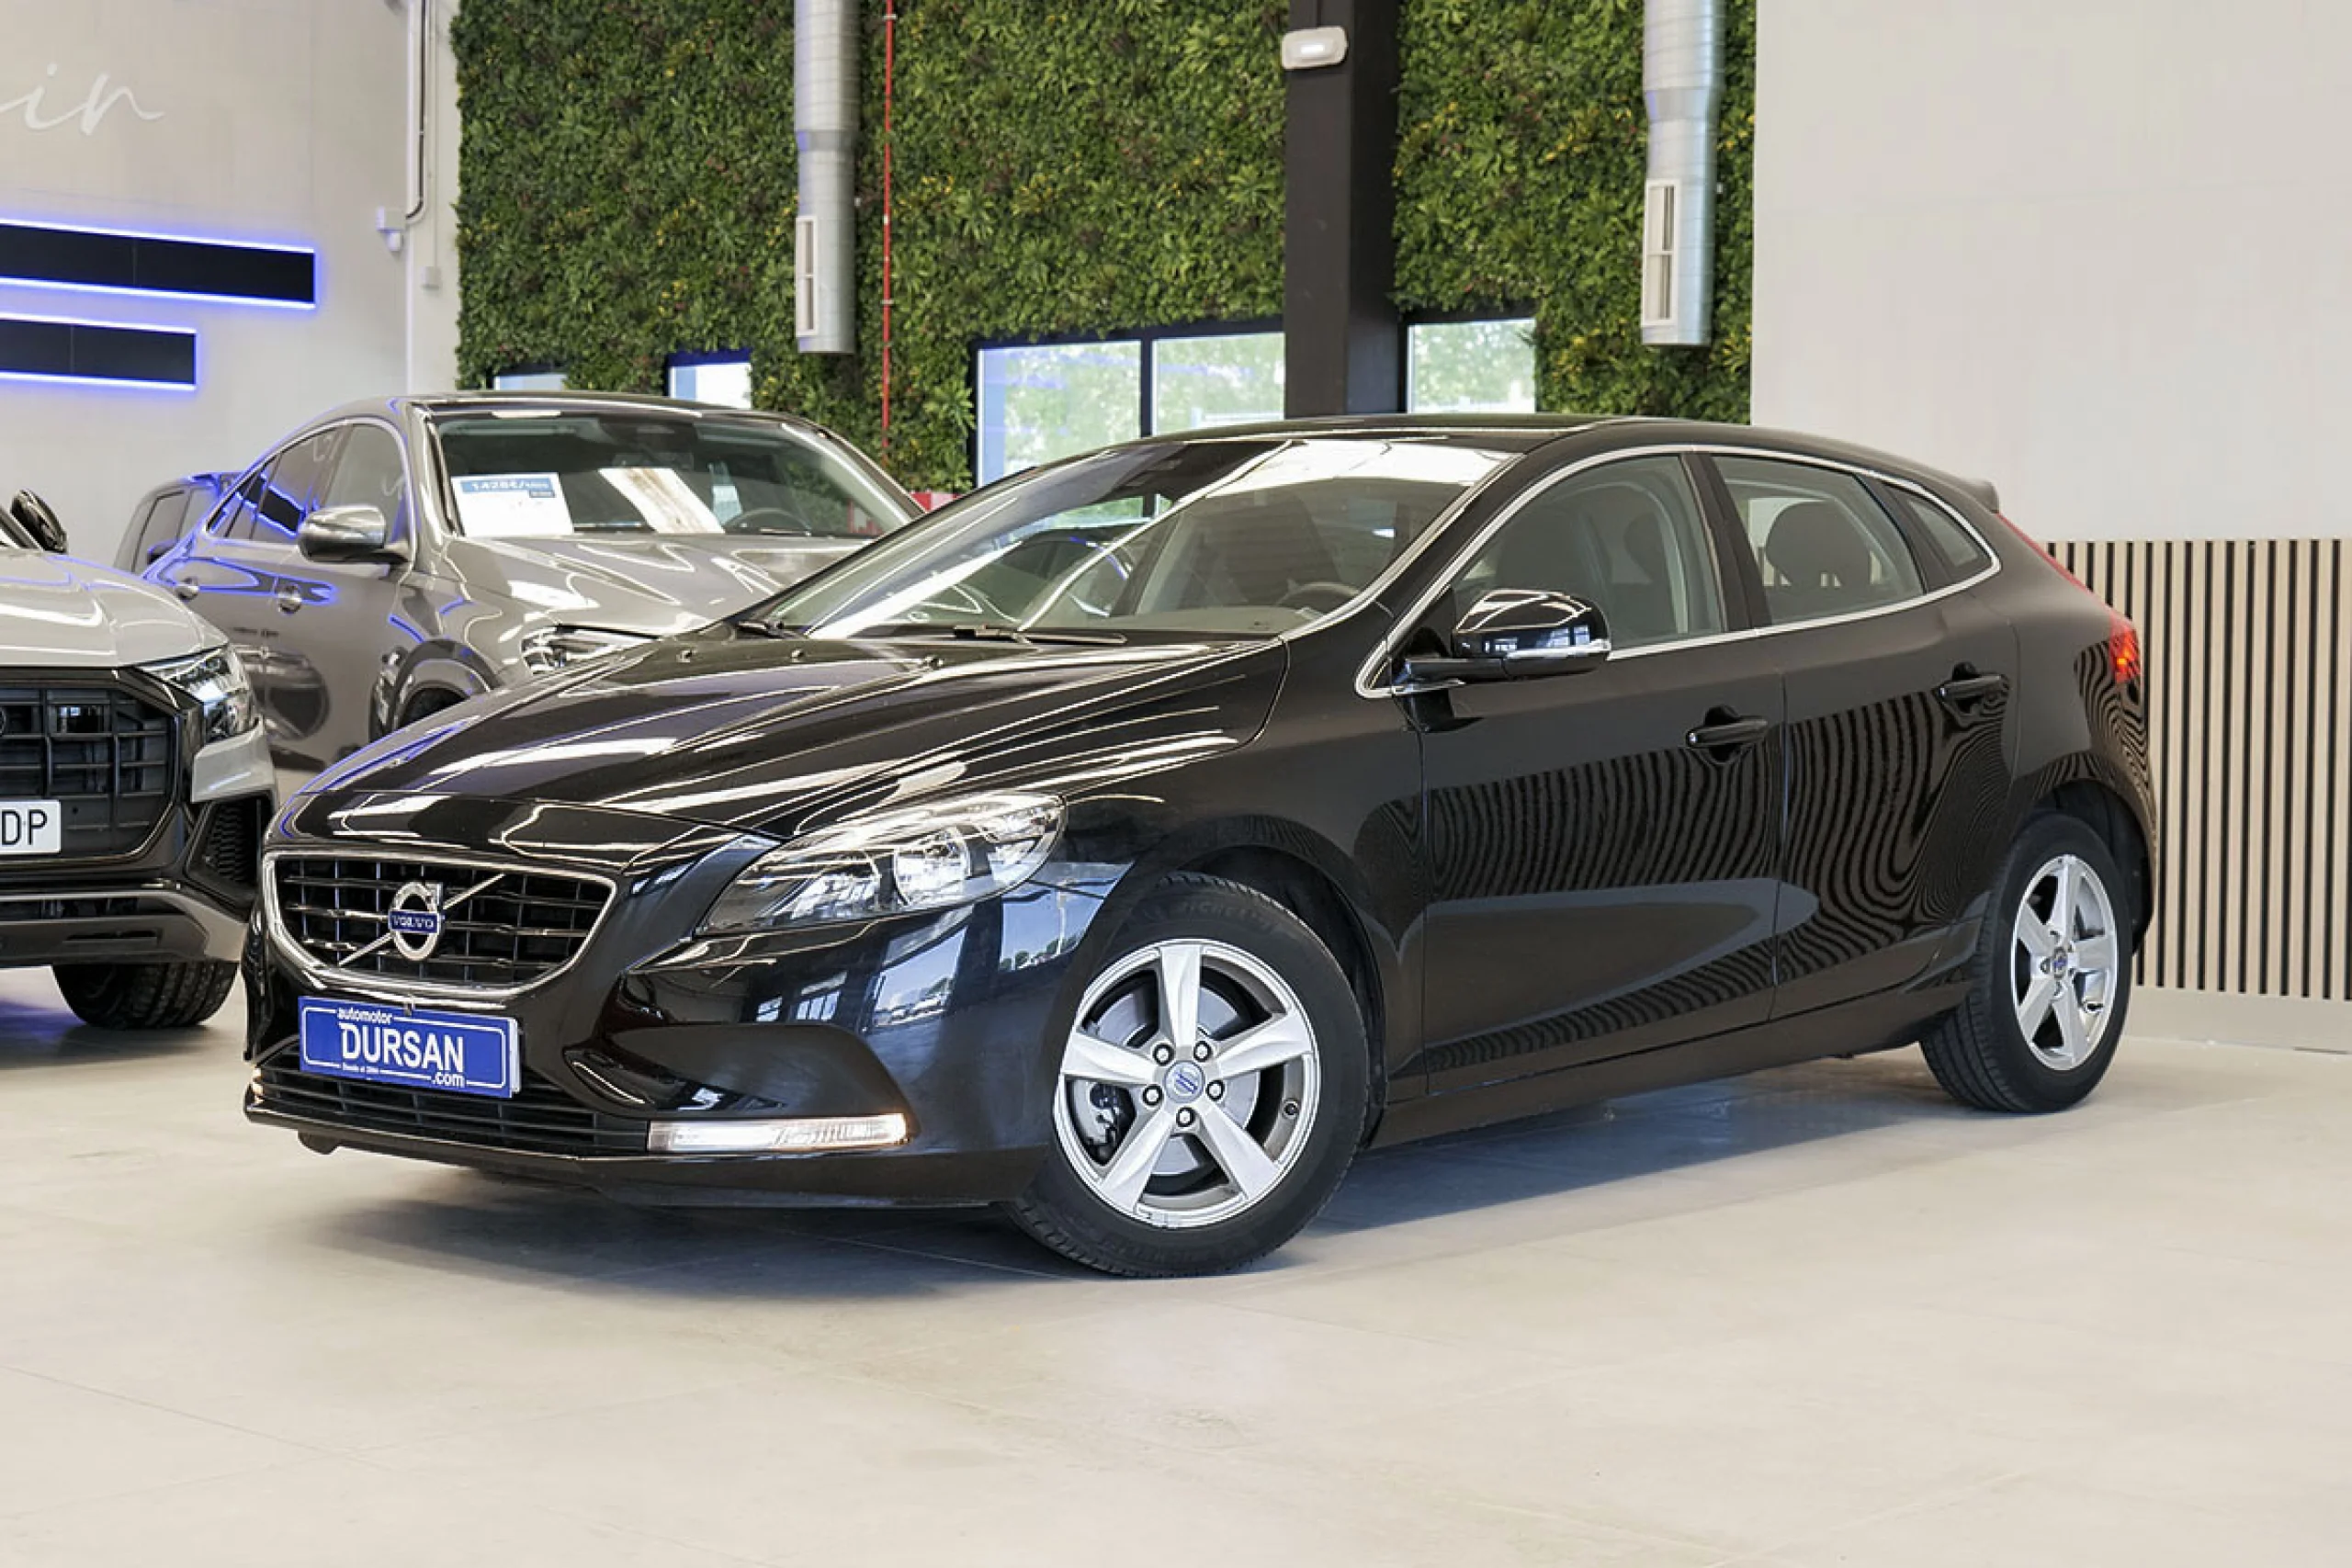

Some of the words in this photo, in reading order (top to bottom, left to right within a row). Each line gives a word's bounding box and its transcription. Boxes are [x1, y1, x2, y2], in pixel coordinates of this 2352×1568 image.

[0, 62, 166, 136] in
[1, 808, 48, 846] DP
[391, 914, 435, 930] VOLVO
[337, 1007, 393, 1026] automotor
[337, 1021, 465, 1073] DURSAN
[431, 1070, 466, 1088] .com
